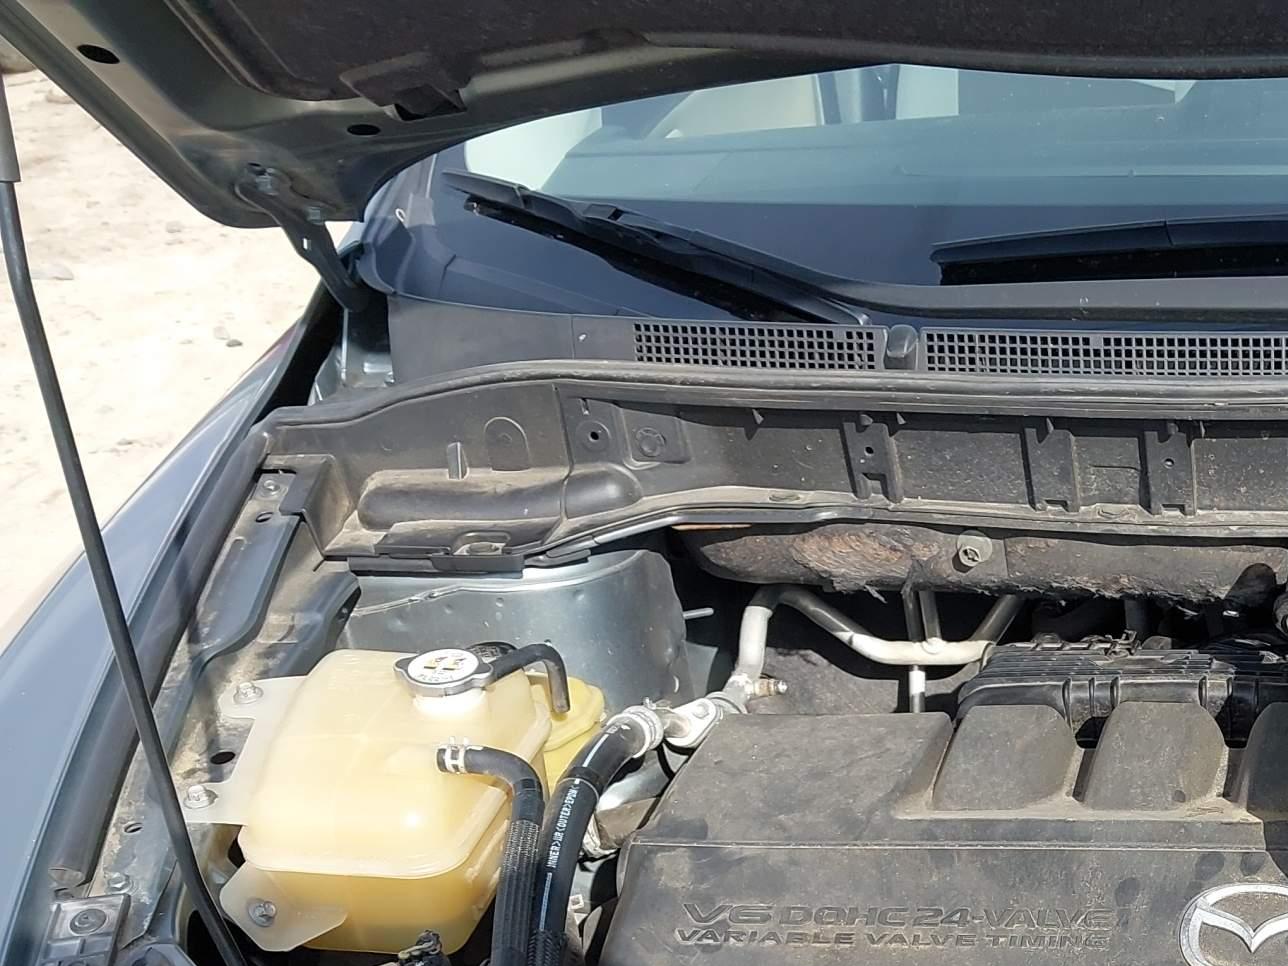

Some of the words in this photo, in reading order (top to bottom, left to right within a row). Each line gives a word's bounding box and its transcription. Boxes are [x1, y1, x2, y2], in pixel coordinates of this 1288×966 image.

[682, 903, 774, 925] V6
[779, 905, 908, 927] DOHC
[912, 906, 1114, 930] 24-VALVE
[675, 928, 856, 946] VARIABLE
[865, 931, 977, 947] VALVE
[985, 934, 1111, 949] TIMING
